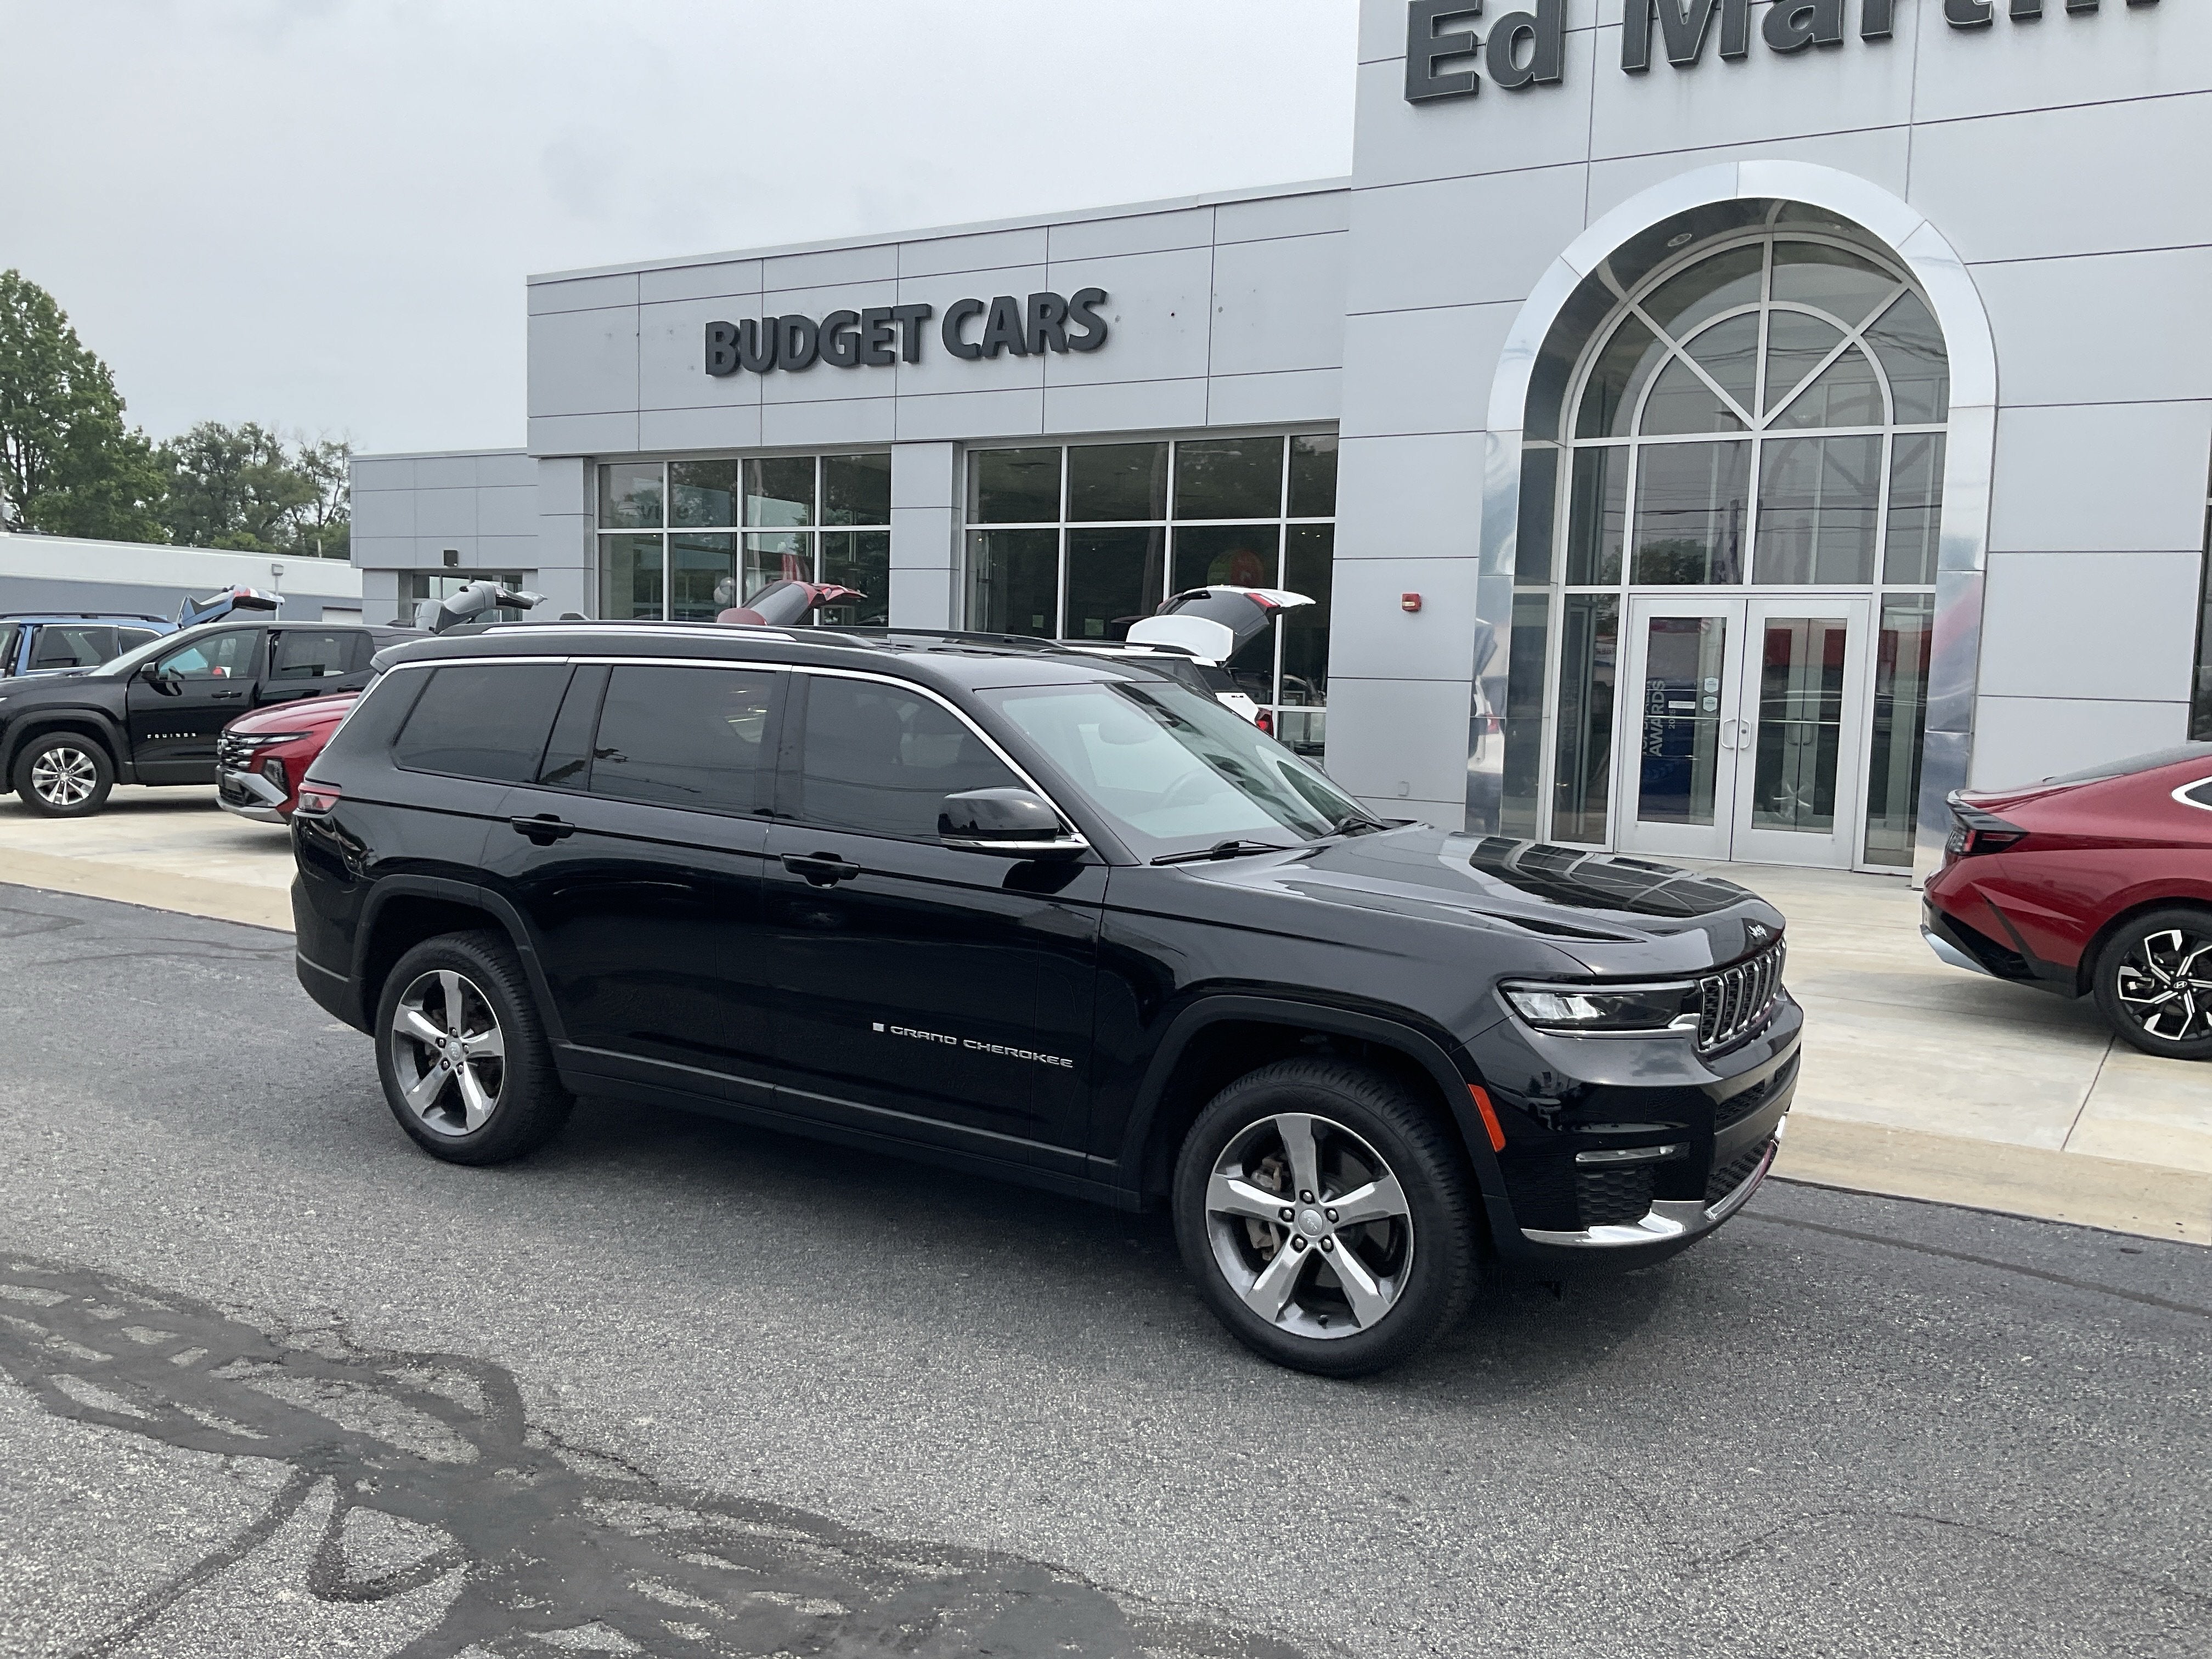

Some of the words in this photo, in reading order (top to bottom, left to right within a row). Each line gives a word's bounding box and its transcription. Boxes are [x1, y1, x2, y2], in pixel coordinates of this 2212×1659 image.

[1404, 0, 1567, 103] Ed
[706, 303, 932, 377] BUDGET
[942, 287, 1108, 360] CARS
[1649, 680, 1666, 757] AWARDS
[890, 1026, 957, 1045] GRAND
[963, 1040, 1073, 1068] CHEROKEE
